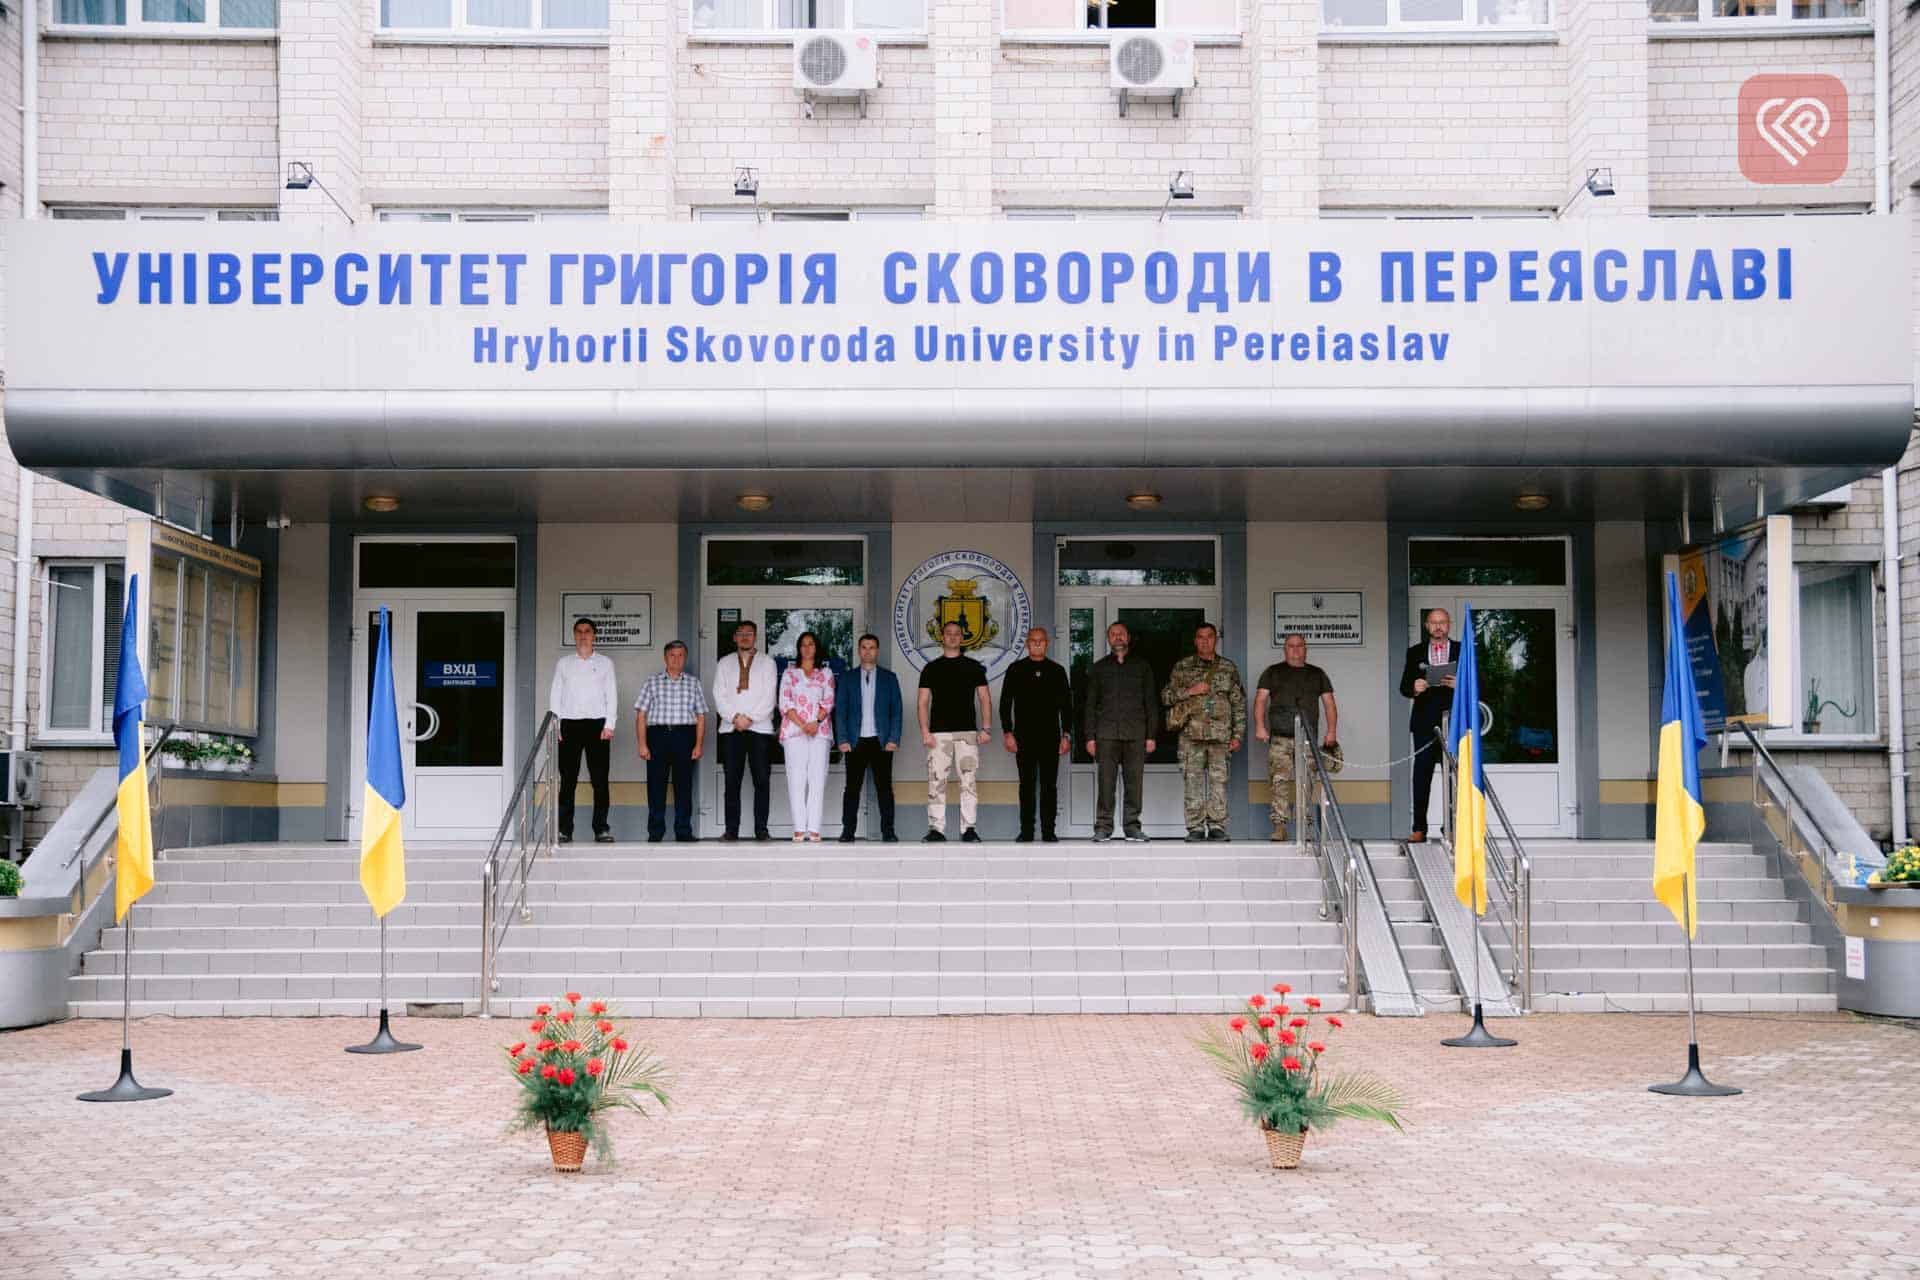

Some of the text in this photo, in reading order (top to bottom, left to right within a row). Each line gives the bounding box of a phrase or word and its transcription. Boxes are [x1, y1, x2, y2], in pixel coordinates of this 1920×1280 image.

[93, 248, 1792, 313] УНІВЕРСИТЕТ ГРИГОРІЯ СКОВОРОДИ В ПЕРЕЯСЛАВІ
[473, 325, 1450, 371] Hryhorii Skovoroda University in Pereiaslav
[443, 663, 477, 676] ВХІД
